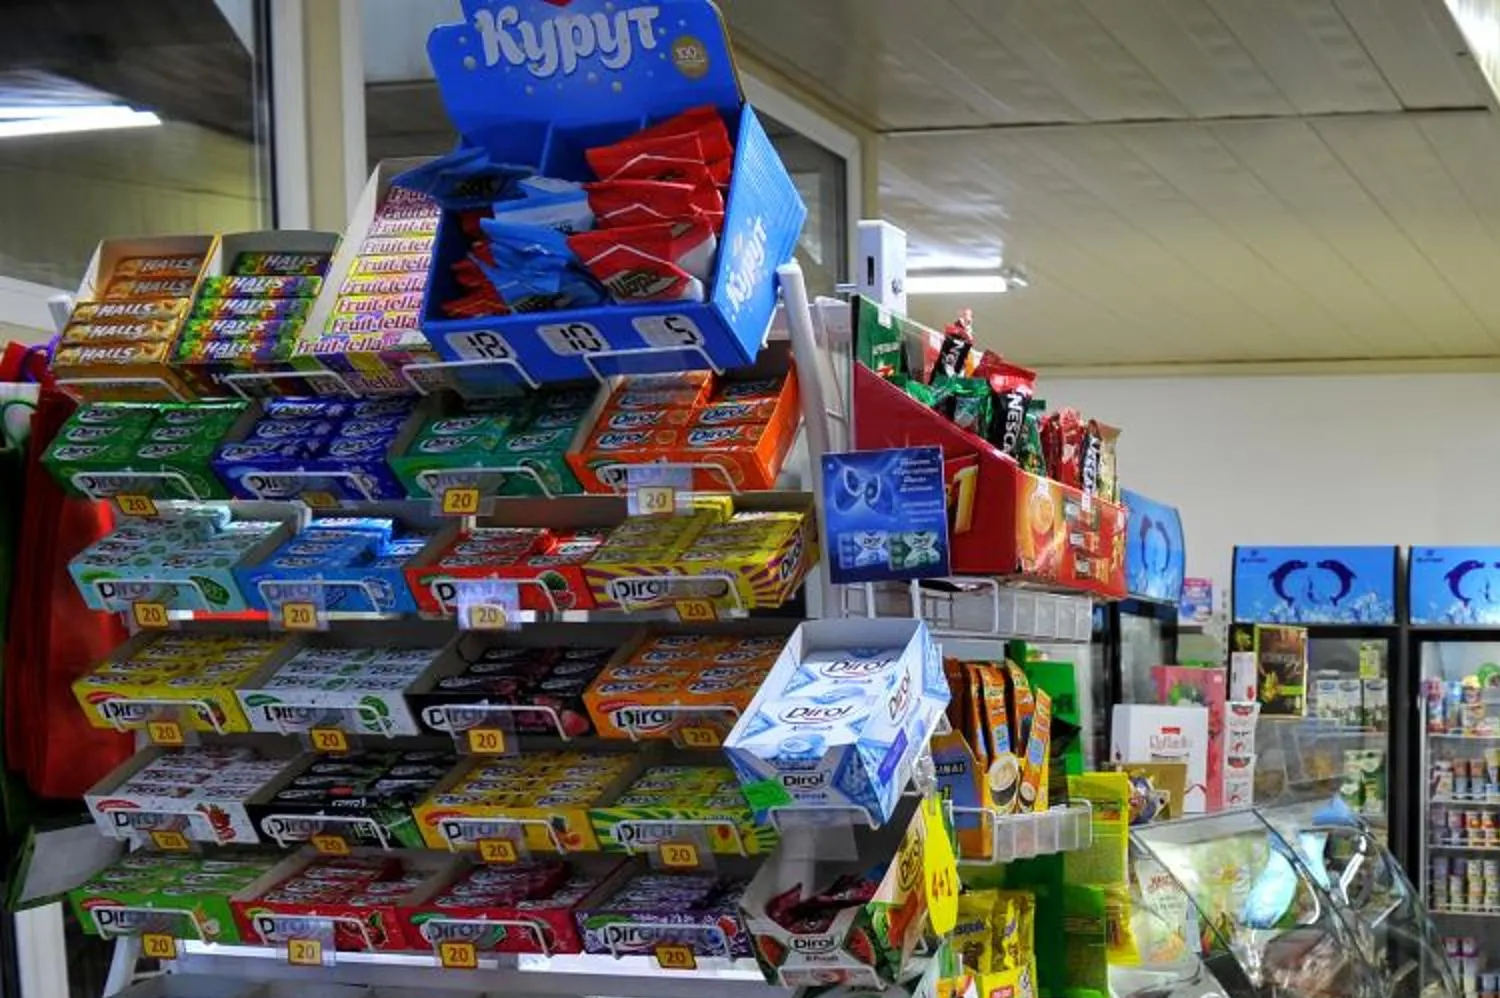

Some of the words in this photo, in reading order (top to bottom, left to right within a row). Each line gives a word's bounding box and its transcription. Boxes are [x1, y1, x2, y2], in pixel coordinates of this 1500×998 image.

[476, 6, 660, 77] Курут
[99, 302, 155, 317] HALLS
[91, 323, 146, 338] HALLS
[560, 324, 601, 352] 10
[664, 317, 699, 344] 5
[79, 347, 135, 362] HALLS
[202, 340, 260, 355] HALLS
[613, 409, 661, 426] Dirol
[702, 403, 755, 421] Dirol
[1003, 392, 1025, 454] NESCA
[599, 429, 652, 445] Dirol
[688, 424, 744, 443] Dirol
[449, 492, 473, 509] 20
[645, 492, 667, 509] 20
[141, 606, 161, 623] 20
[290, 606, 310, 624] 20
[476, 607, 498, 624] 20
[826, 658, 892, 674] Dirol
[615, 710, 673, 729] Dirol
[787, 703, 853, 720] Dirol
[319, 733, 339, 748] 20
[476, 733, 497, 749] 20
[782, 773, 825, 789] Dirol
[670, 847, 692, 863] 20
[296, 943, 315, 959] 20
[792, 935, 834, 951] Dirol
[449, 948, 469, 962] 20
